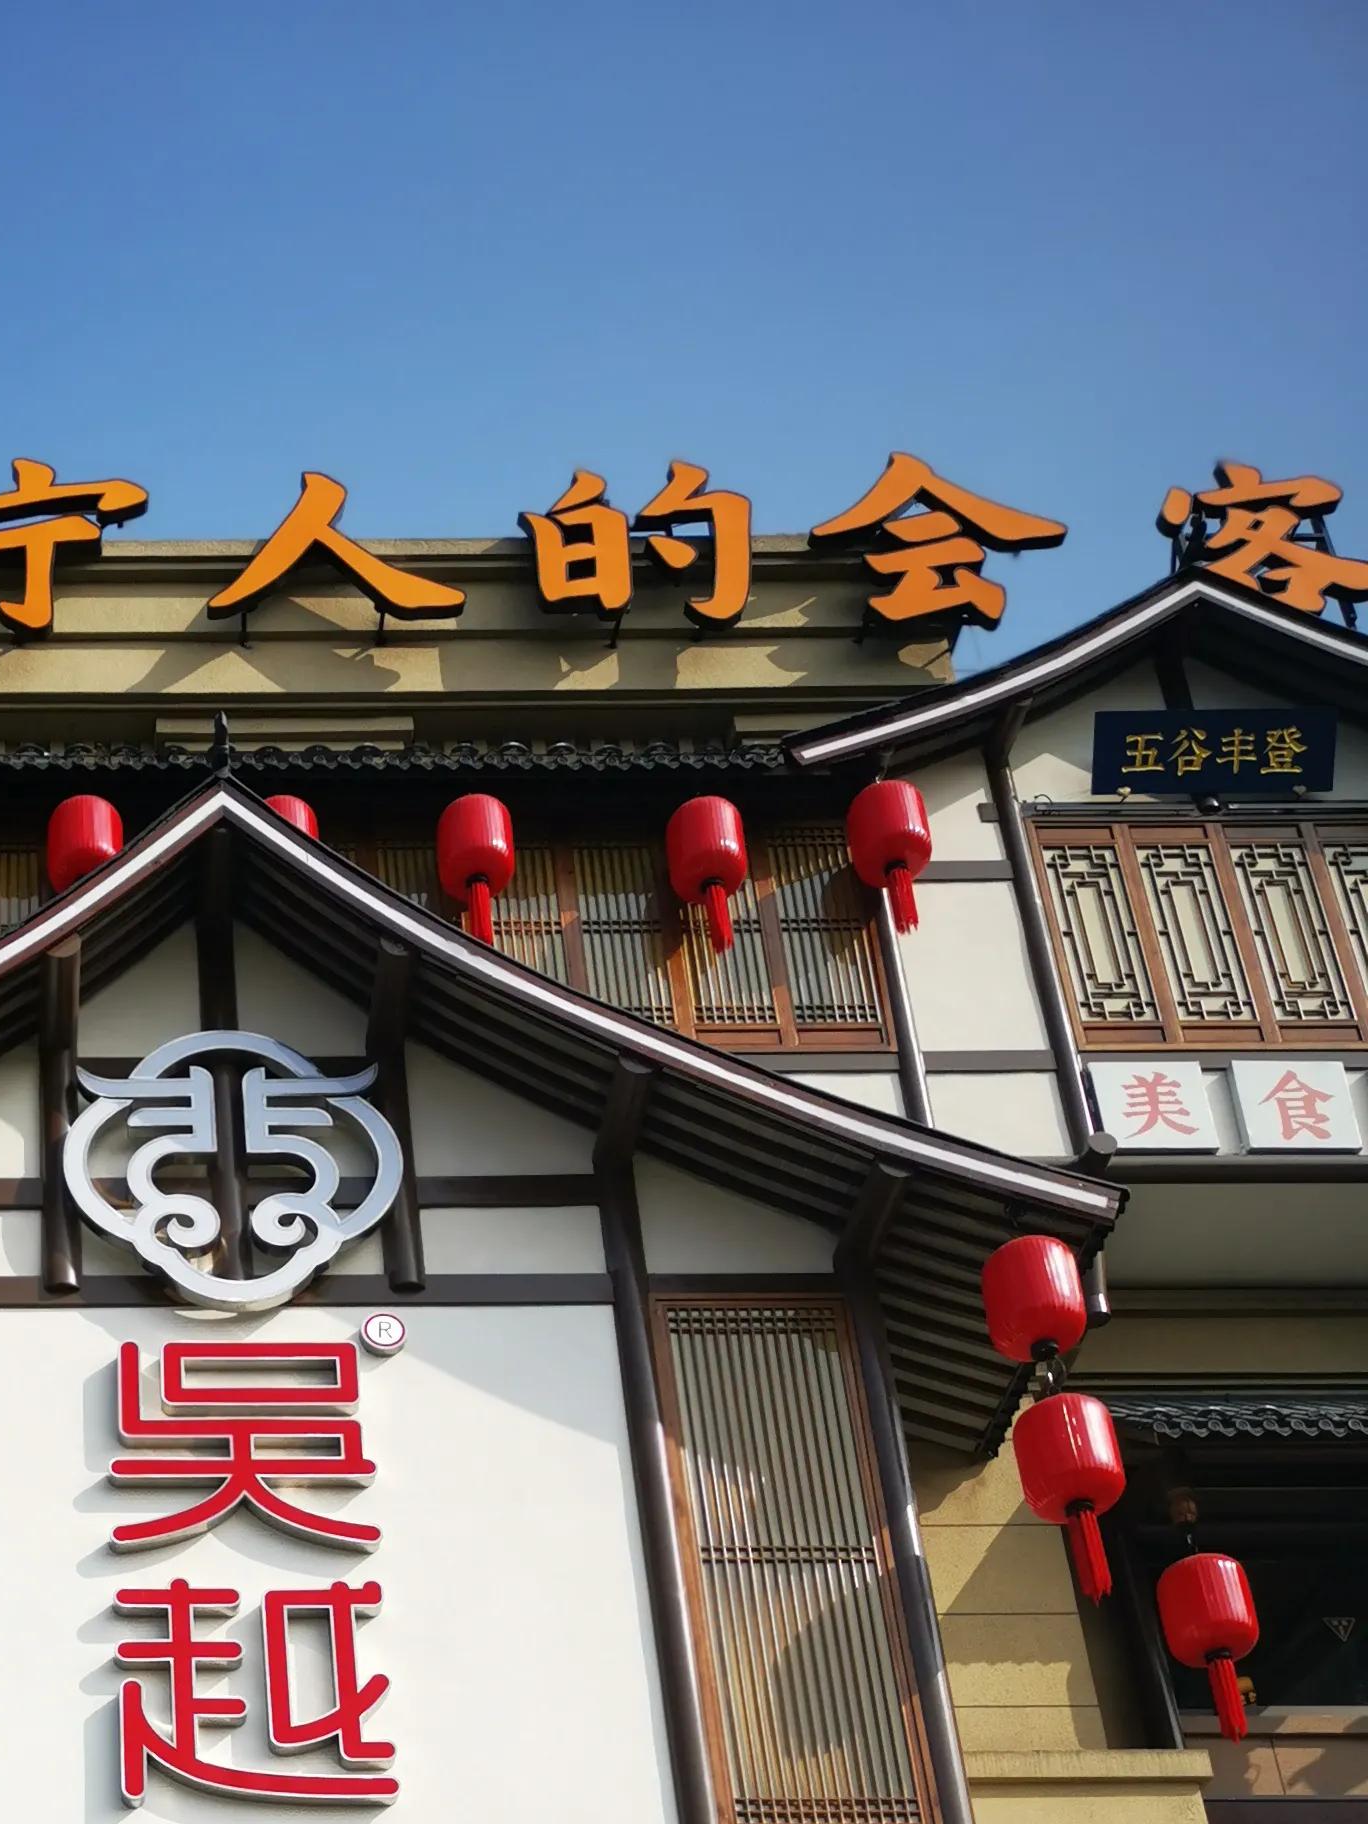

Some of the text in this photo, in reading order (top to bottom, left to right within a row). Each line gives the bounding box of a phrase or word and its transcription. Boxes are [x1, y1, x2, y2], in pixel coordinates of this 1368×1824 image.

[1120, 724, 1309, 777] 五谷丰登
[1120, 1069, 1336, 1141] 美食
